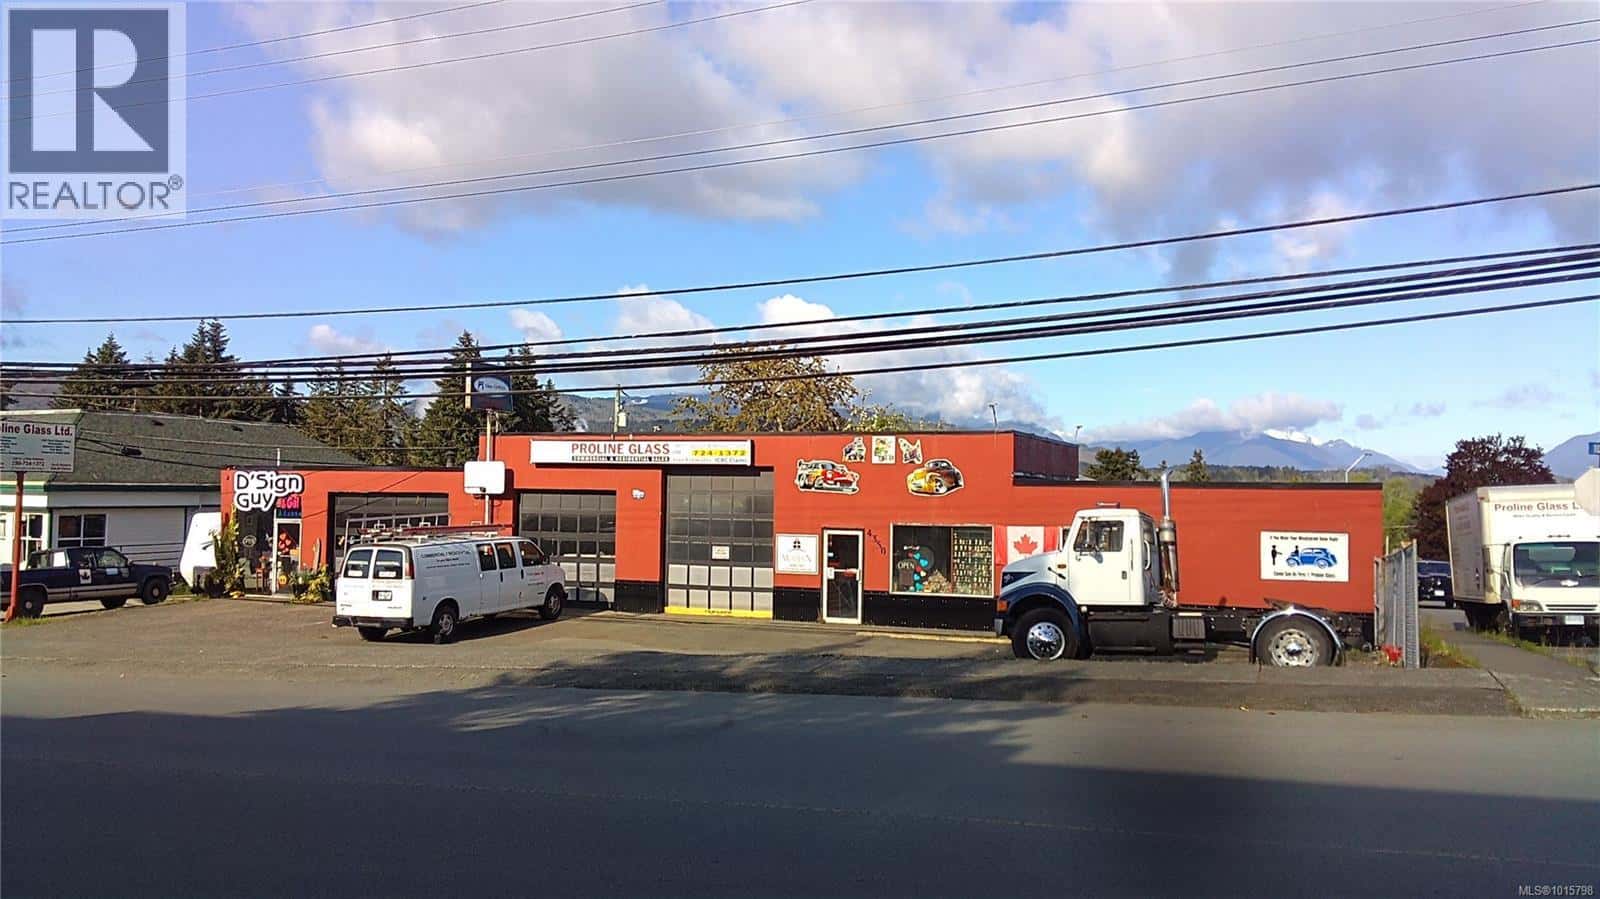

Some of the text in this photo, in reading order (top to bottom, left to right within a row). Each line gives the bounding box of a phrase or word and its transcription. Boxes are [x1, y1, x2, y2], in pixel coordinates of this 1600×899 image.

[0, 423, 73, 436] line Glass Ltd.
[572, 443, 624, 454] PROLINE
[628, 443, 670, 454] GLASS
[236, 473, 300, 494] D'Sign
[236, 492, 273, 509] Guy
[1494, 503, 1533, 512] Proline
[1536, 502, 1568, 511] Glass
